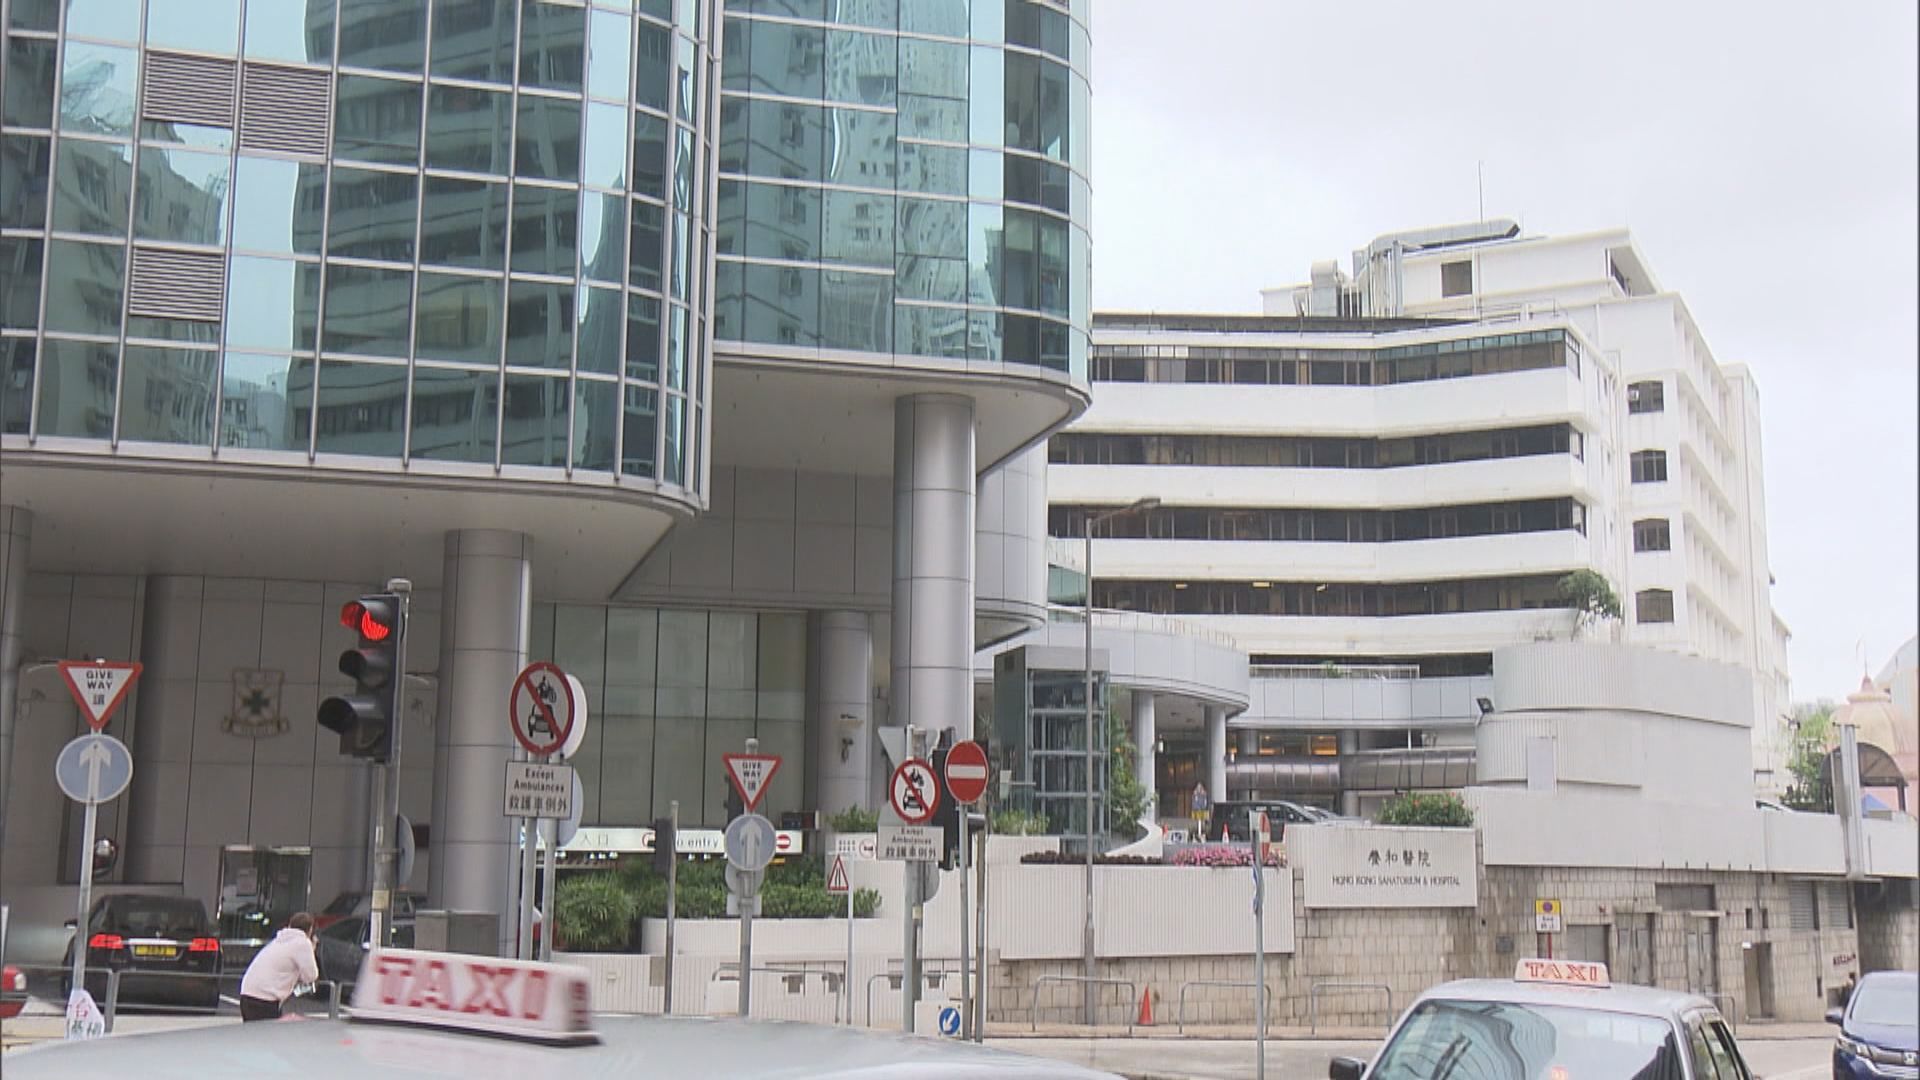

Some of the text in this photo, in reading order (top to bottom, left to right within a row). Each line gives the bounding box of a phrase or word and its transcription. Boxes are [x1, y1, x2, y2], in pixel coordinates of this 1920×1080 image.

[86, 670, 113, 679] GIVE
[87, 680, 112, 690] WAY
[525, 767, 554, 780] Except
[743, 770, 761, 778] WAY
[514, 779, 564, 793] Ambulances
[509, 794, 567, 812] 救護車例外
[581, 832, 609, 847] 入口
[688, 836, 719, 849] entry
[1332, 875, 1354, 886] HONG
[1355, 875, 1376, 886] KONG
[1378, 875, 1421, 886] SANATORIUM
[1430, 875, 1460, 886] HOSPITAL
[1525, 962, 1597, 981] TAXI
[376, 956, 547, 1021] TAXI
